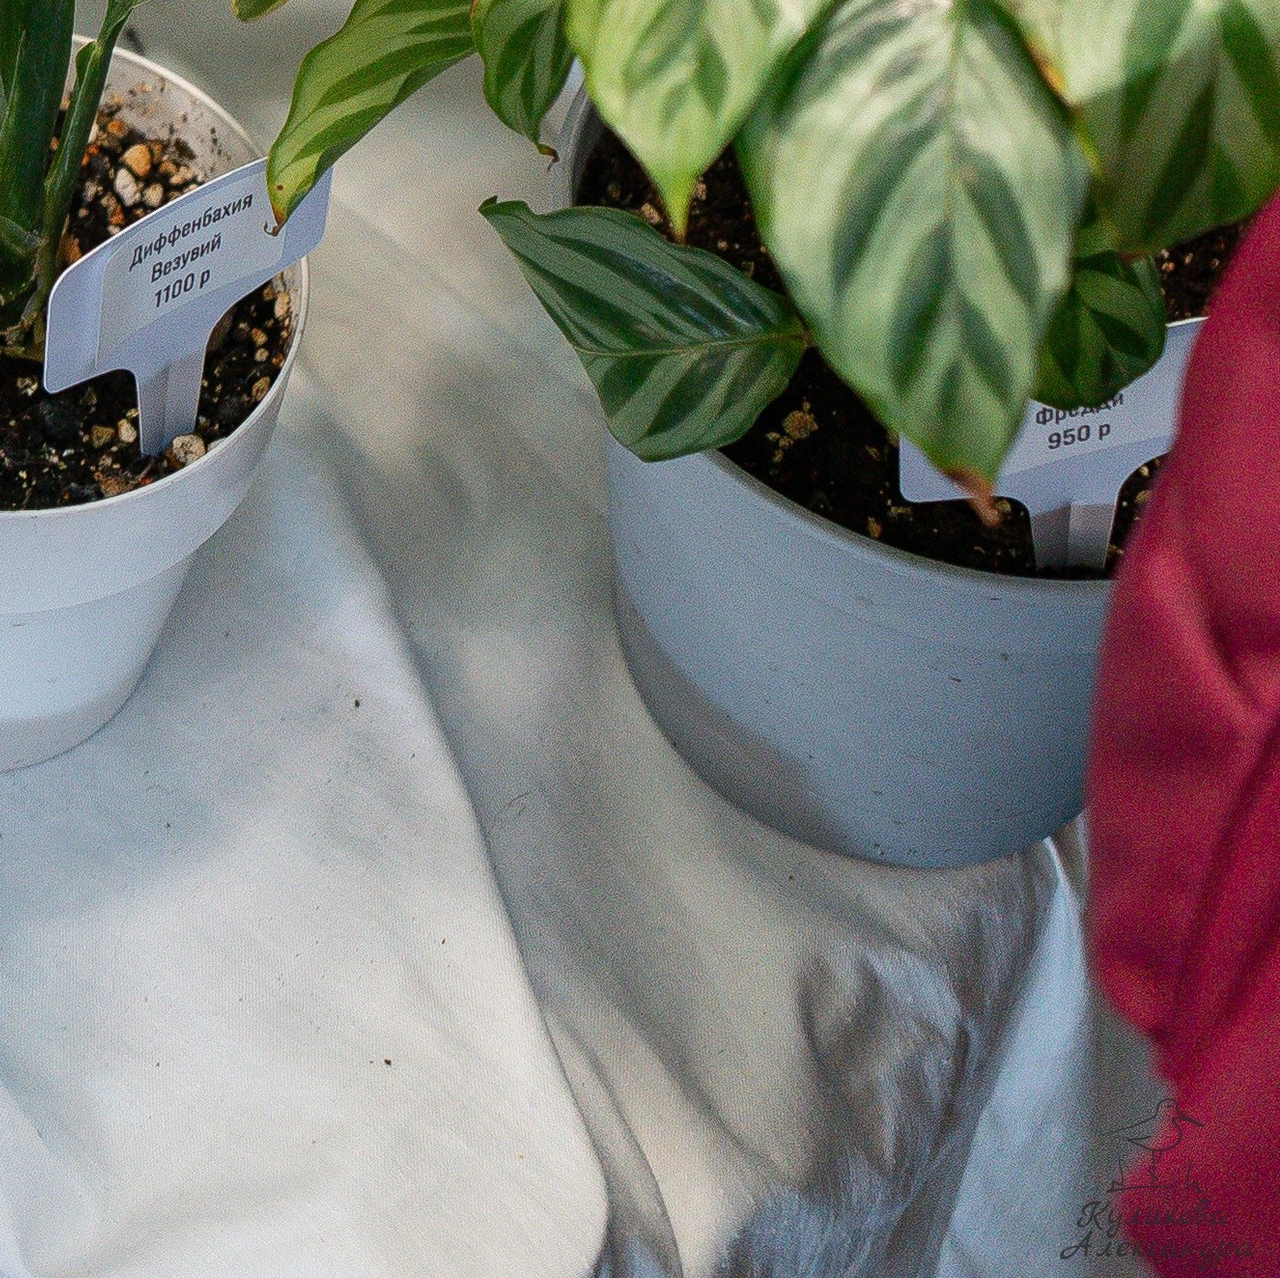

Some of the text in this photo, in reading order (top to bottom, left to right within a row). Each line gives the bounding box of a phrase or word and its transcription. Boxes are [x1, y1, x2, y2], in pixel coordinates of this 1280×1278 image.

[128, 193, 254, 272] Диффенбахия
[150, 232, 222, 283] Везувий
[154, 269, 211, 308] 1100 р
[1047, 423, 1112, 450] 950 р
